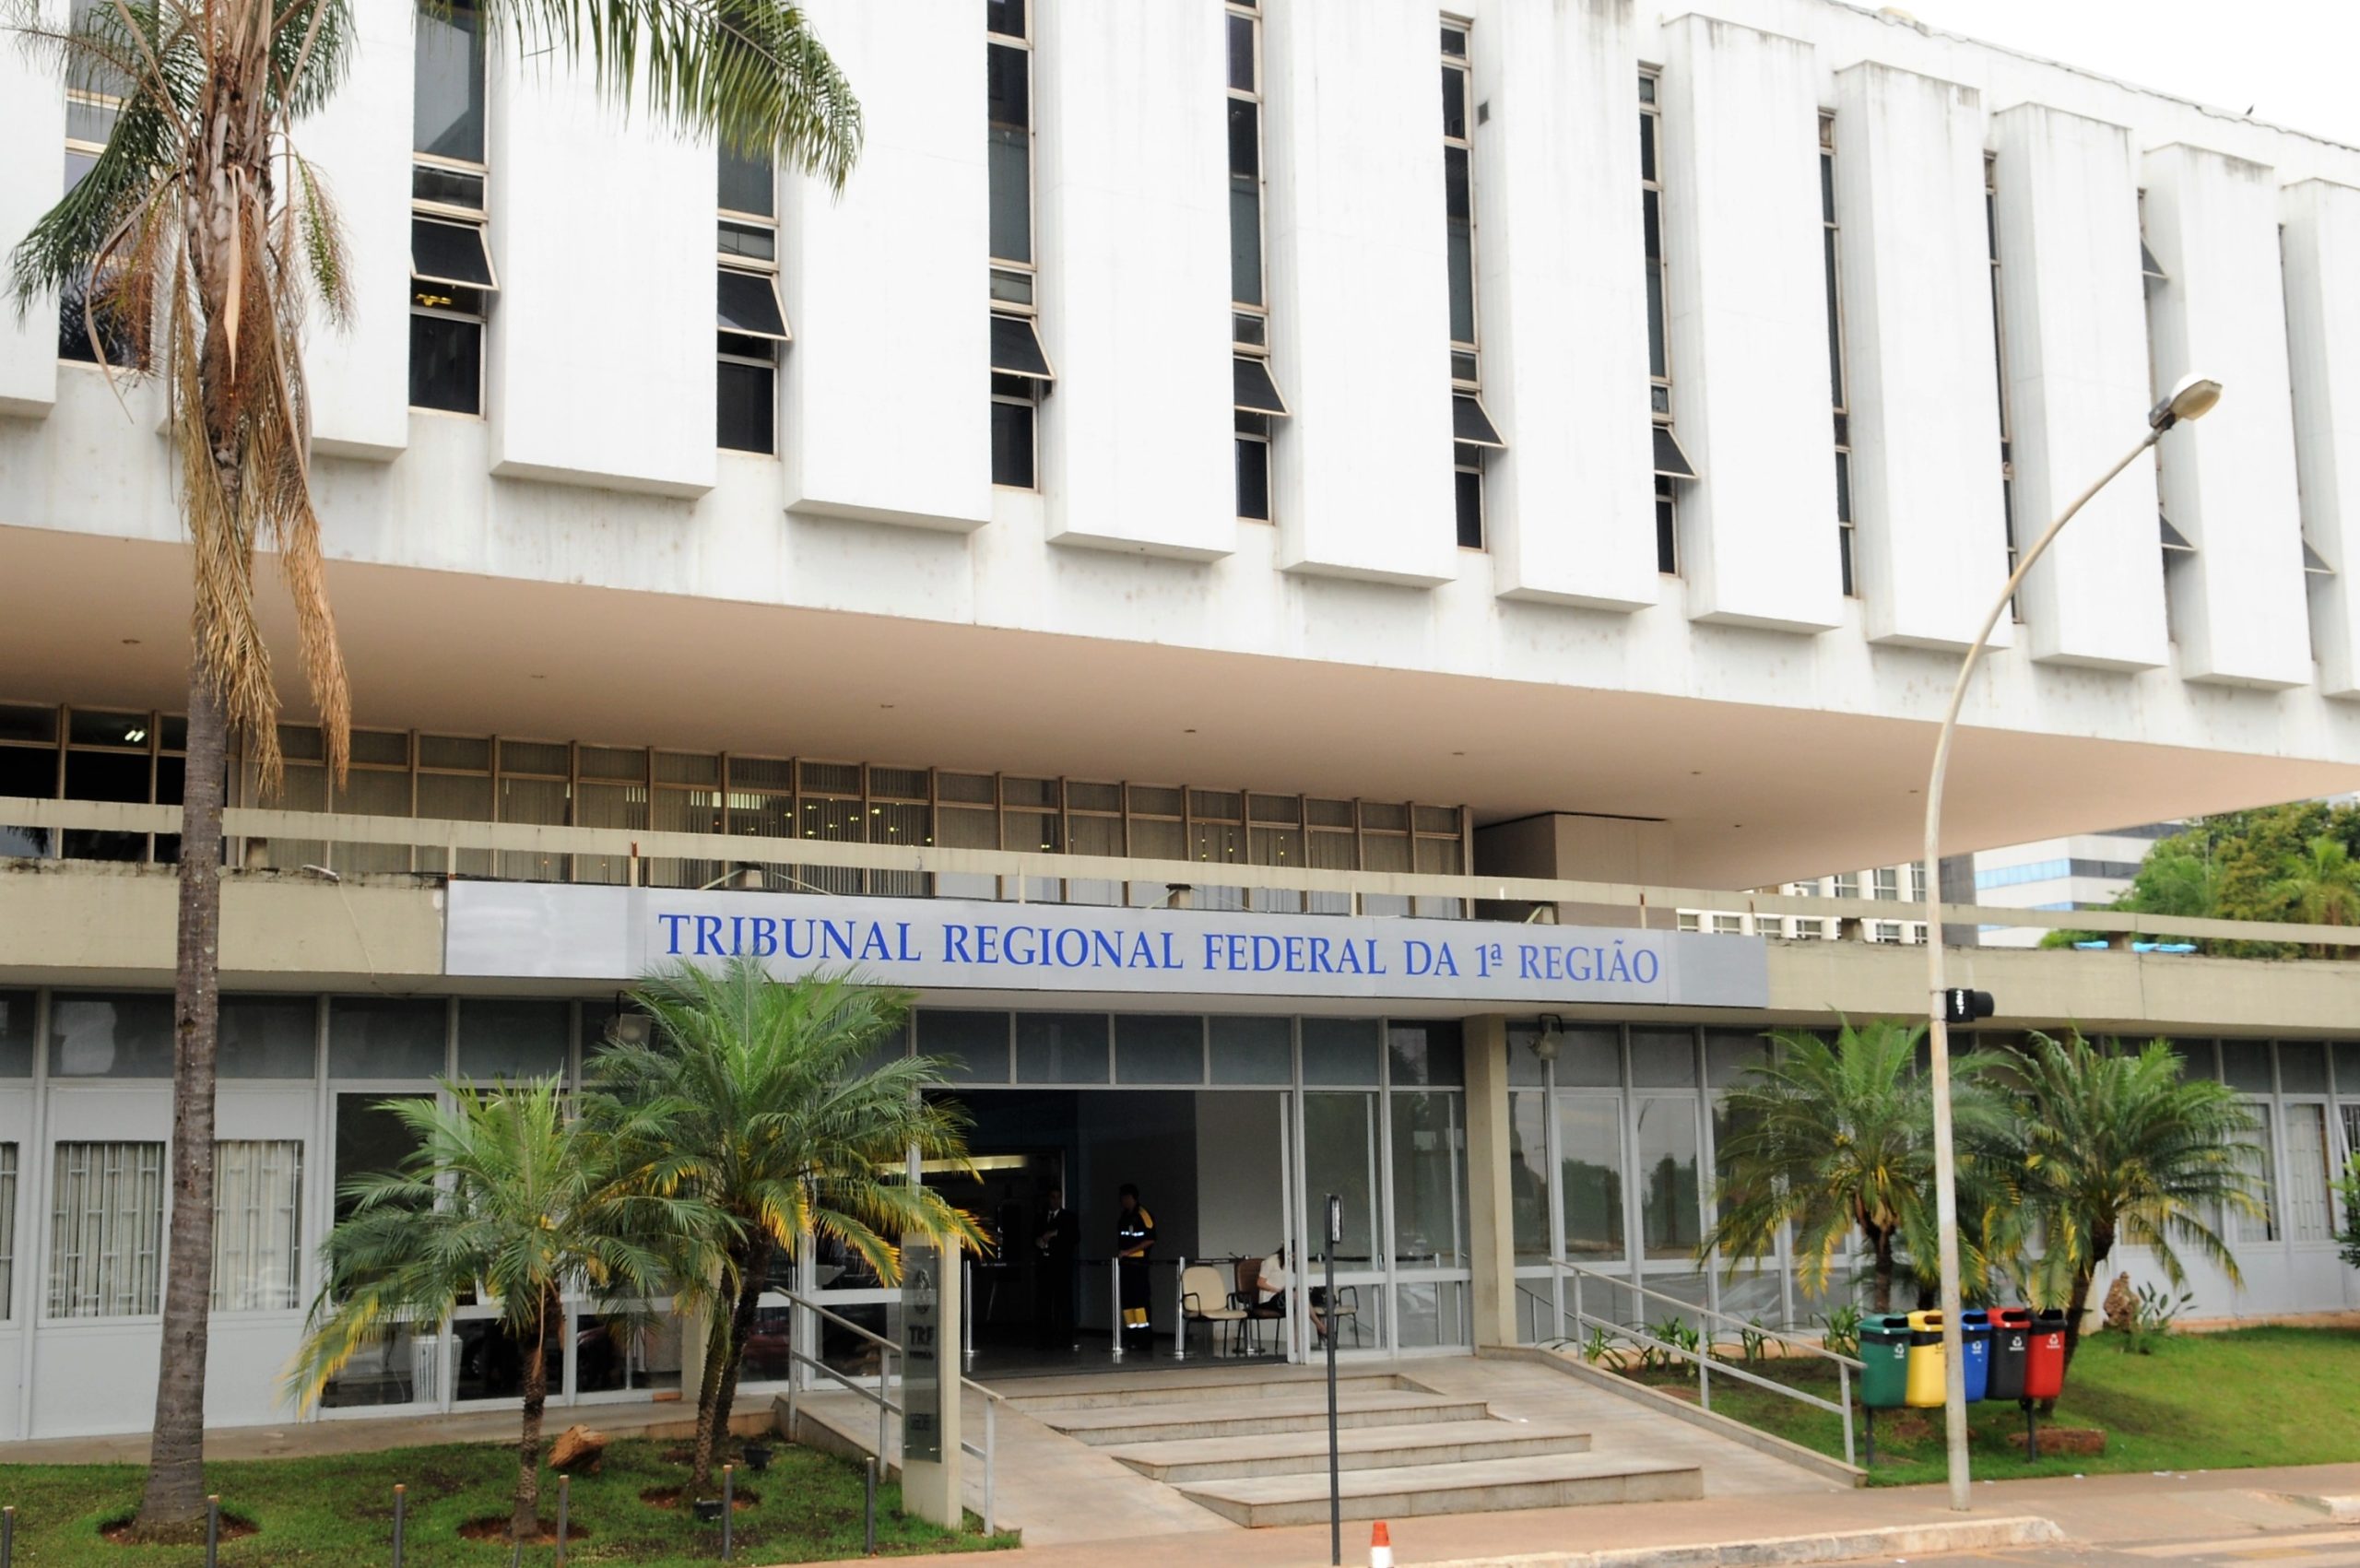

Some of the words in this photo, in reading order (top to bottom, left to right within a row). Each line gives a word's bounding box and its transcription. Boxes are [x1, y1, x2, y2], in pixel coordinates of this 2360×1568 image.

[657, 914, 923, 961] TRIBUNAL
[942, 923, 1186, 970] REGIONAL
[1203, 932, 1387, 975] FEDERAL
[1403, 939, 1460, 977] DA
[1476, 943, 1504, 978] 1ª
[1518, 939, 1659, 984] REGIÃO
[908, 1325, 934, 1346] TRF
